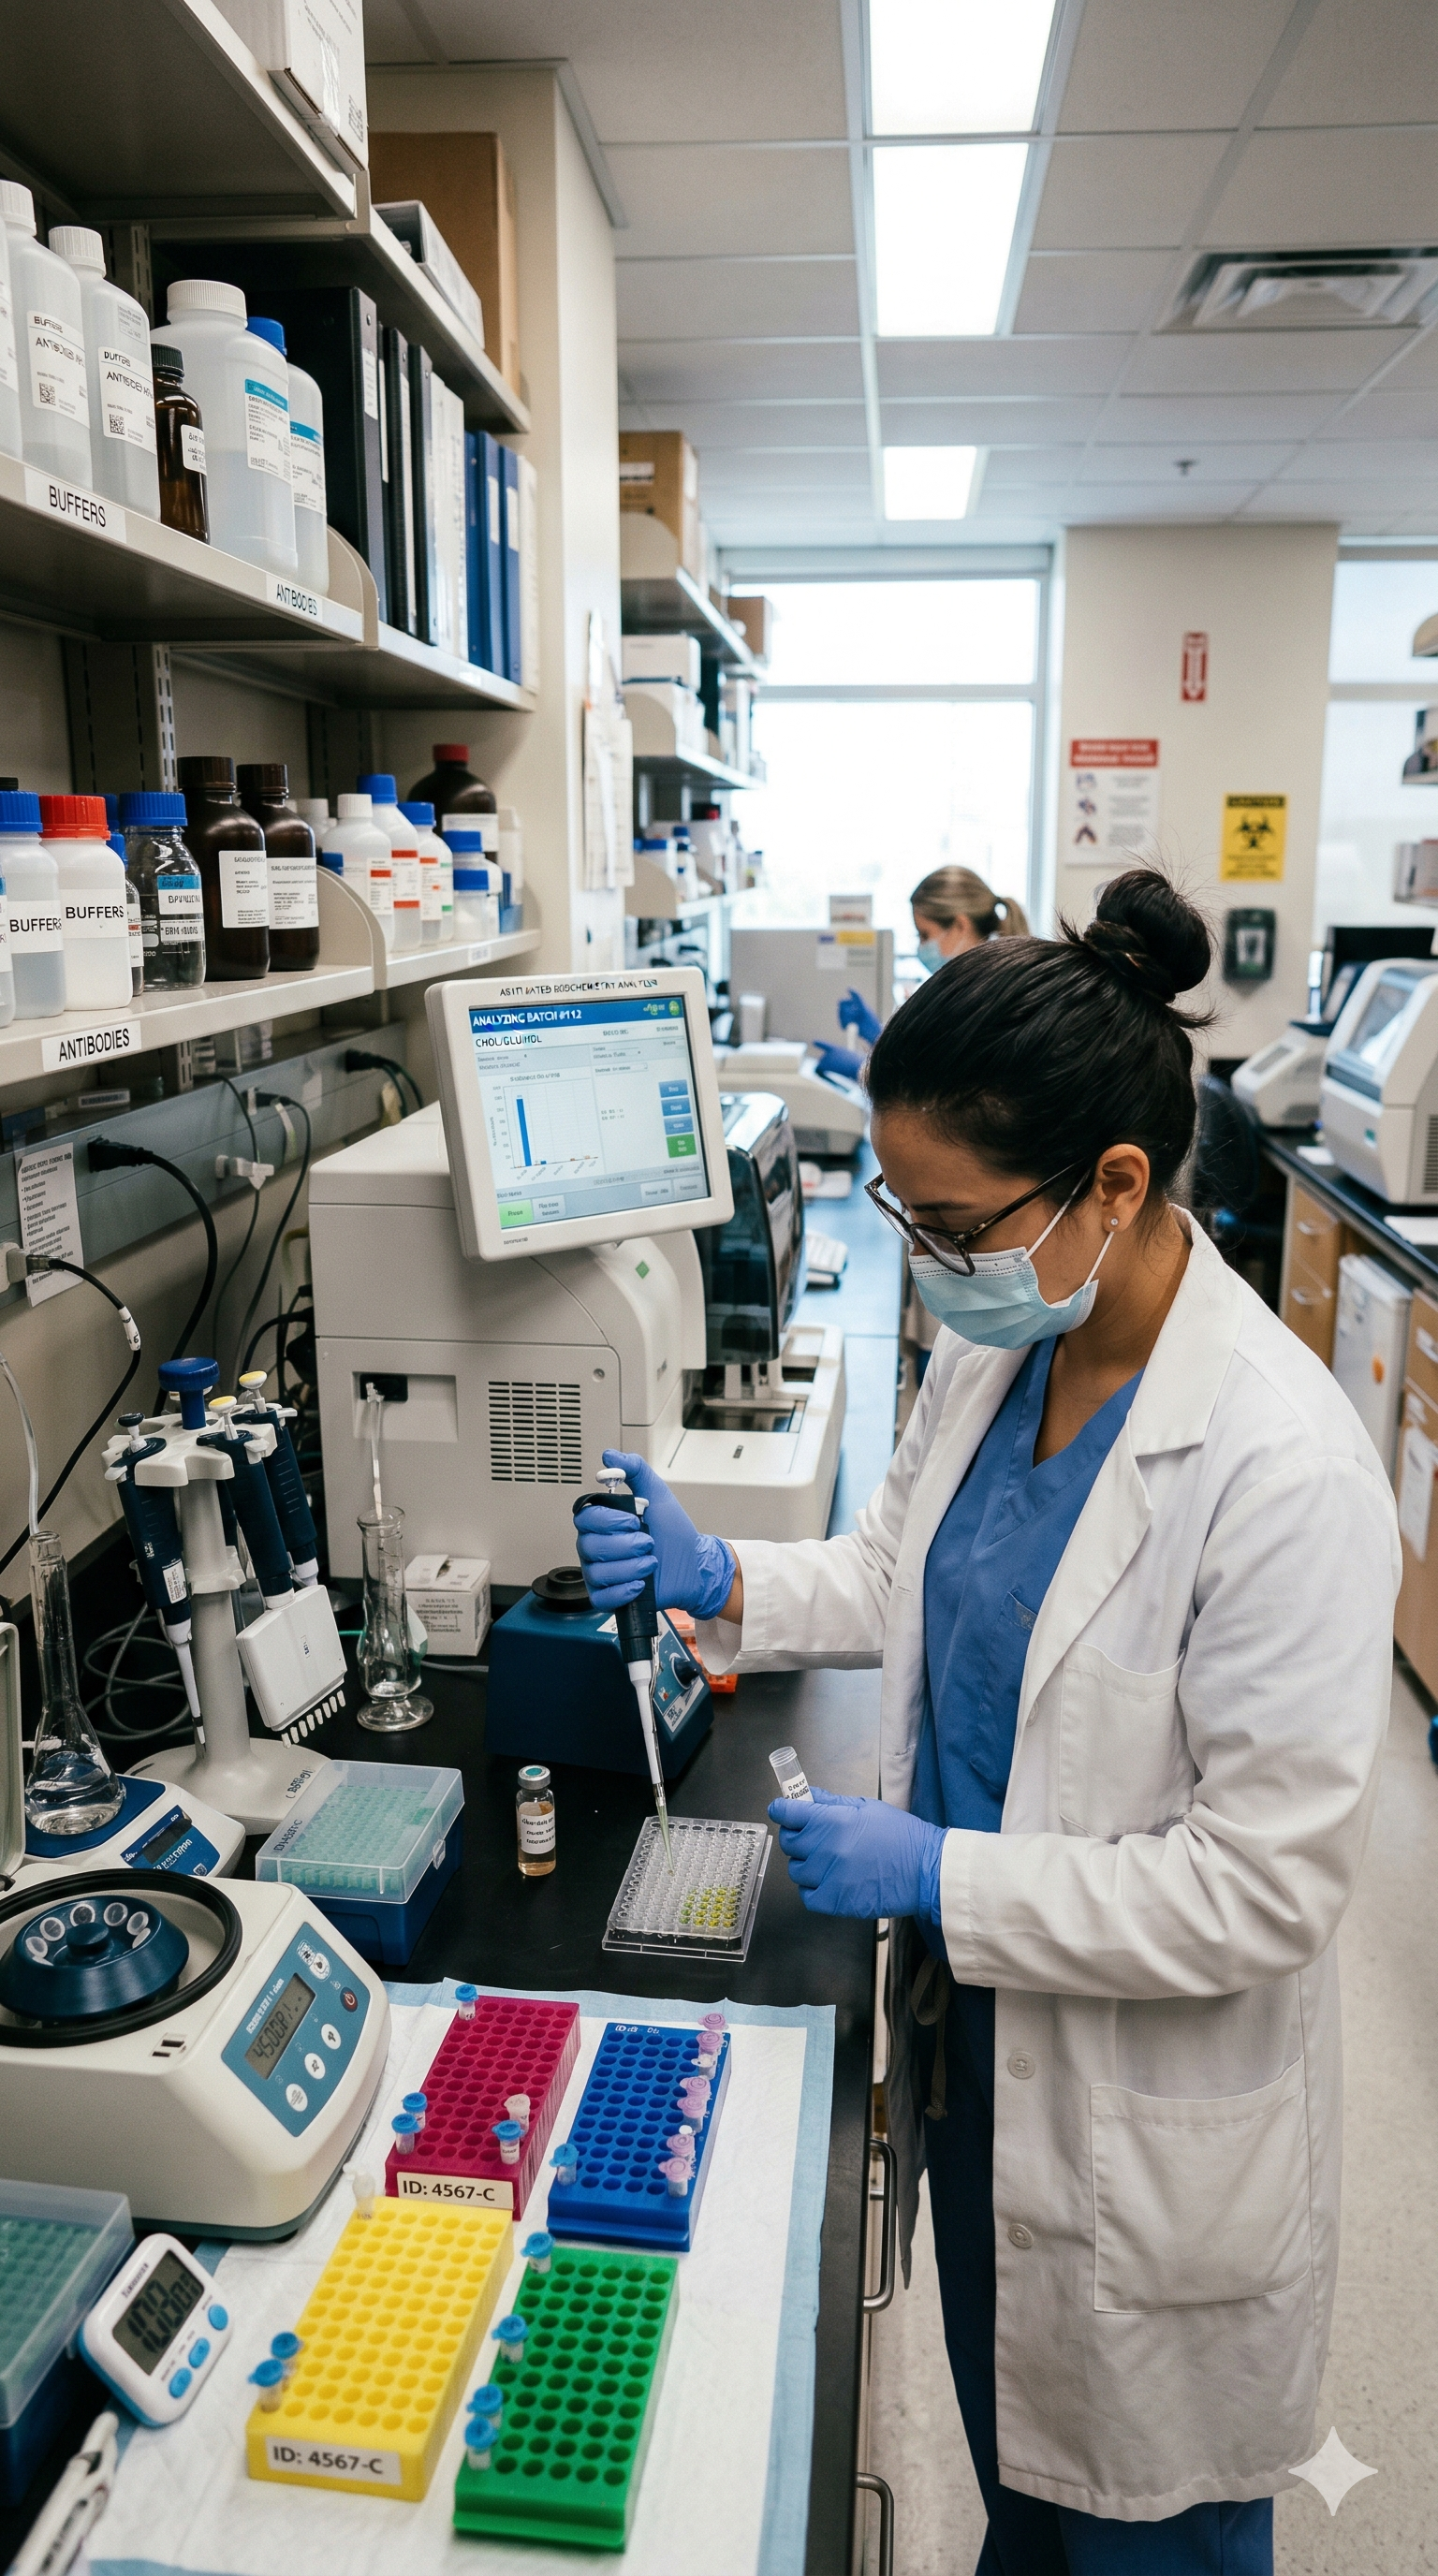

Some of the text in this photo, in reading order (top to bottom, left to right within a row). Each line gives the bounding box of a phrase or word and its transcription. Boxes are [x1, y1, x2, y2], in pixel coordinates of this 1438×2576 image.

[49, 485, 106, 527] BUFFERS
[65, 905, 124, 919] BUFFERS
[59, 1028, 130, 1062] ANTIBODIES
[403, 2180, 495, 2202] ID: 4567-C
[273, 2446, 383, 2475] ID: 4567-C
